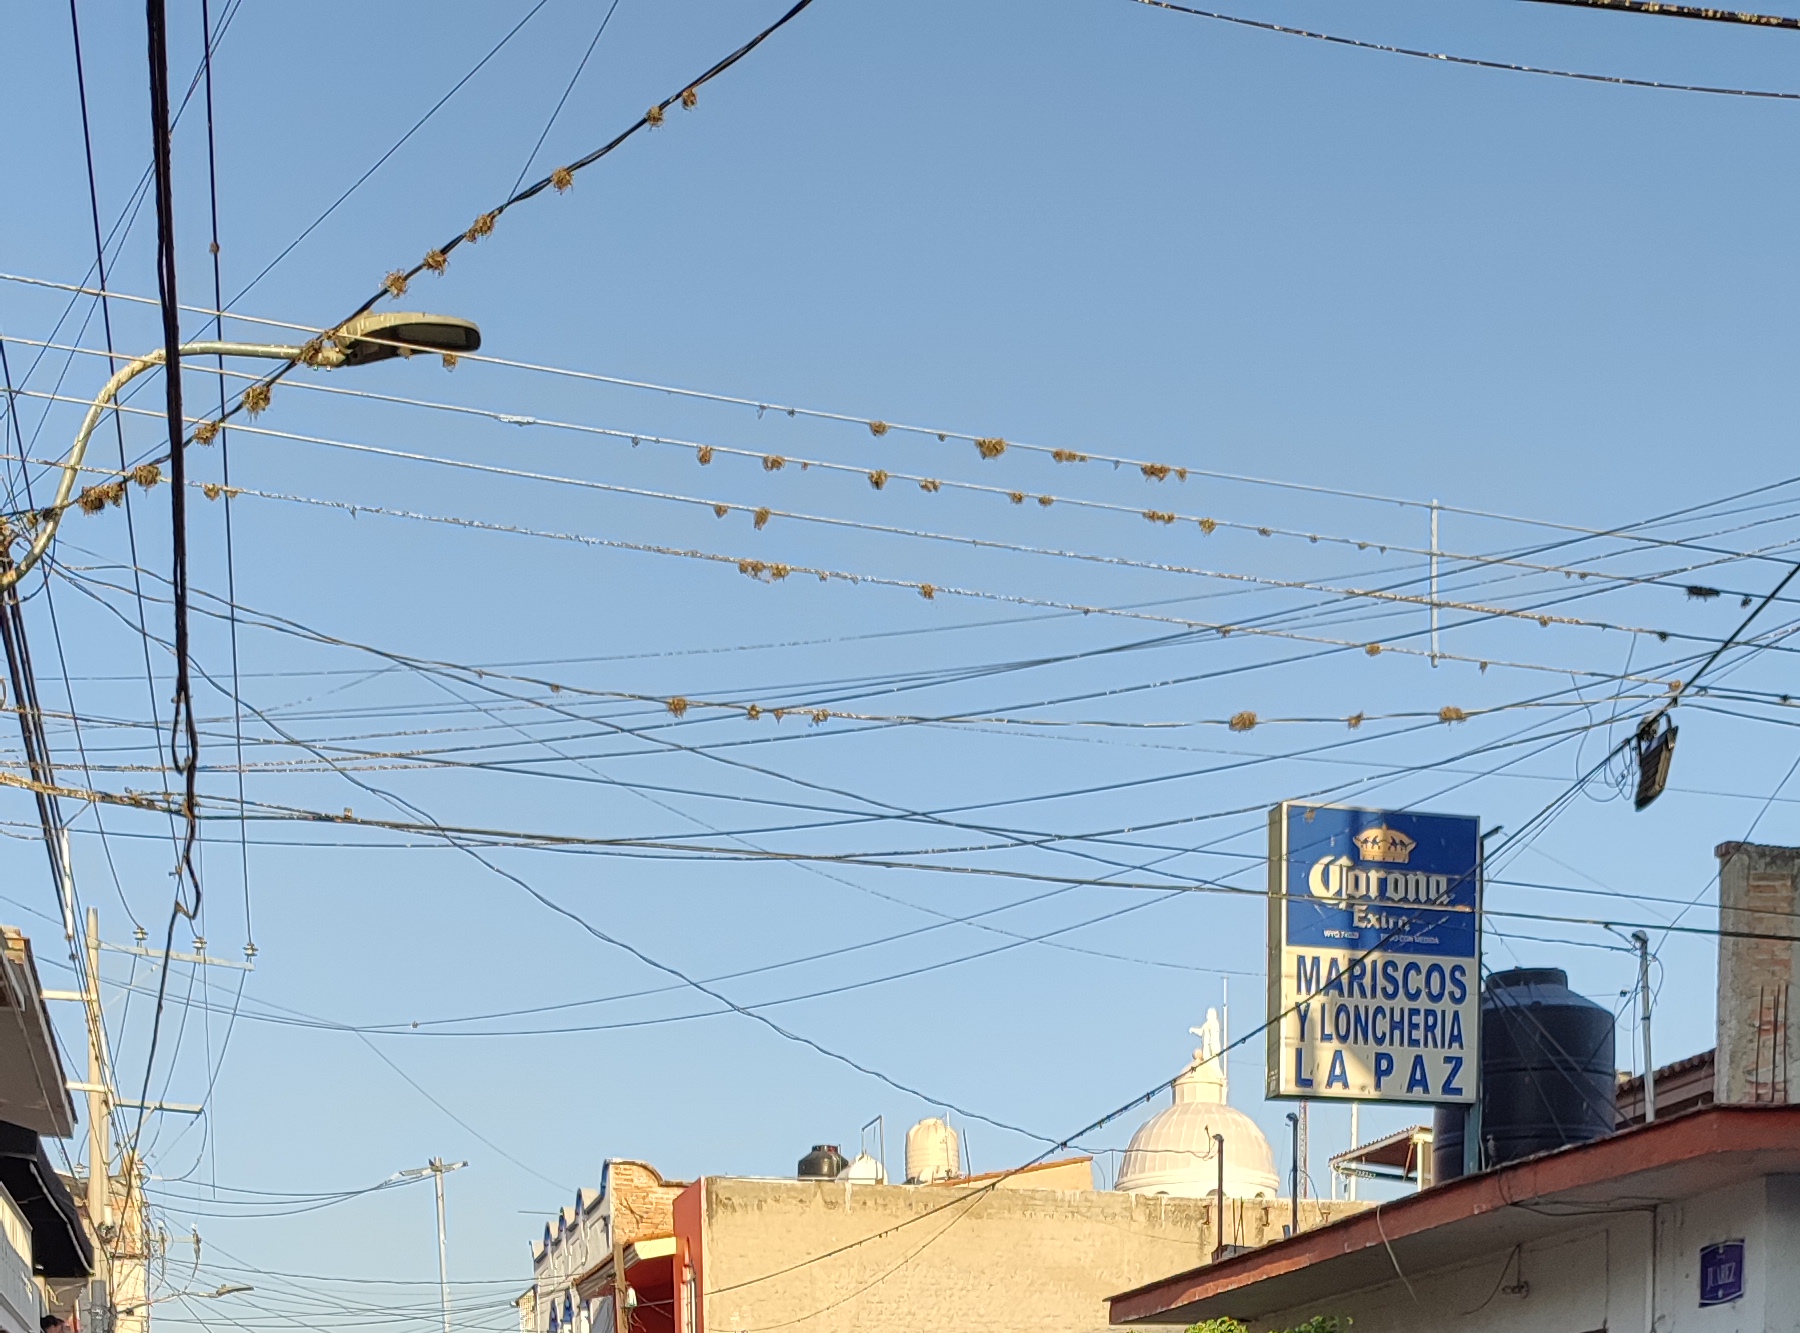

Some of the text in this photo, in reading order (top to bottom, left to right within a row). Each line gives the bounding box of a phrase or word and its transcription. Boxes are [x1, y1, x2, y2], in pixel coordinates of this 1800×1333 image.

[1309, 855, 1454, 910] Corona
[1353, 905, 1410, 931] Extra
[1297, 955, 1467, 1004] MARISCOS
[1296, 1002, 1464, 1050] Y LONCHERIA
[1295, 1048, 1463, 1096] LA PAZ
